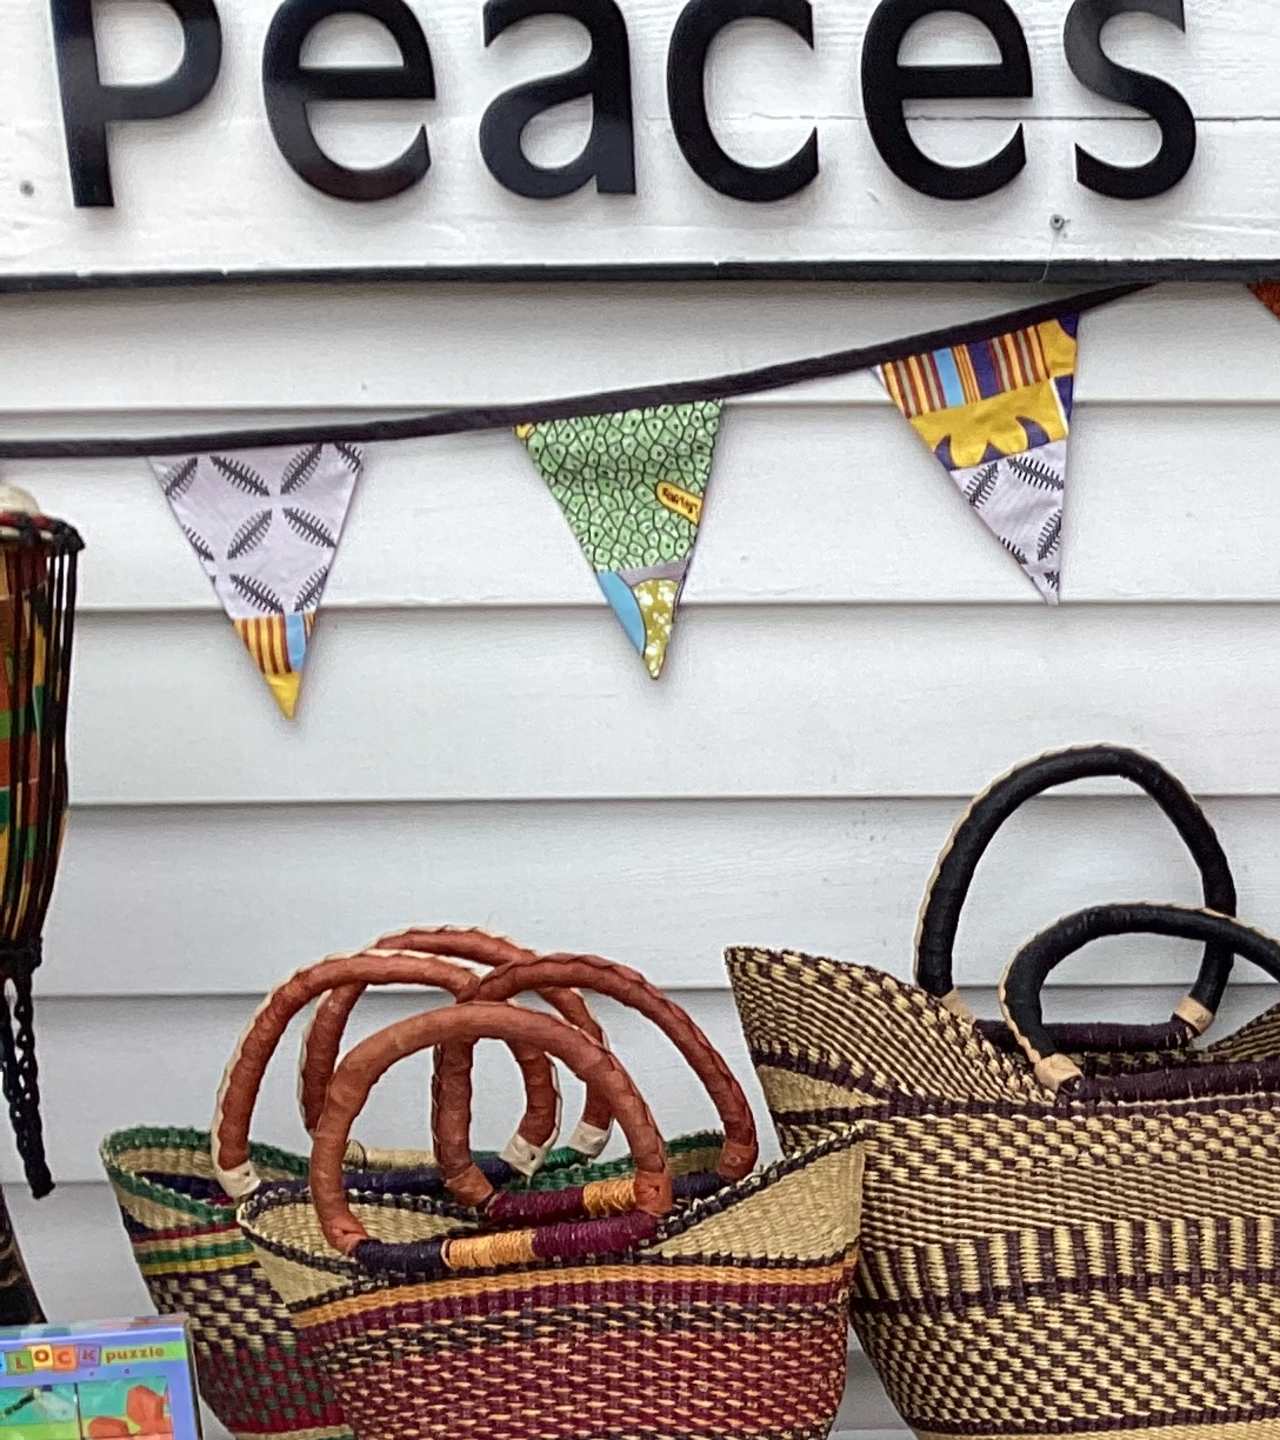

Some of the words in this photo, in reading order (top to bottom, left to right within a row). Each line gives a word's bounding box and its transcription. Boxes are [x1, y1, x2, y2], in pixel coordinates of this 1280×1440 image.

[50, 0, 1199, 208] Peaces
[0, 1348, 96, 1370] LOCK
[105, 1347, 165, 1363] puzzle
